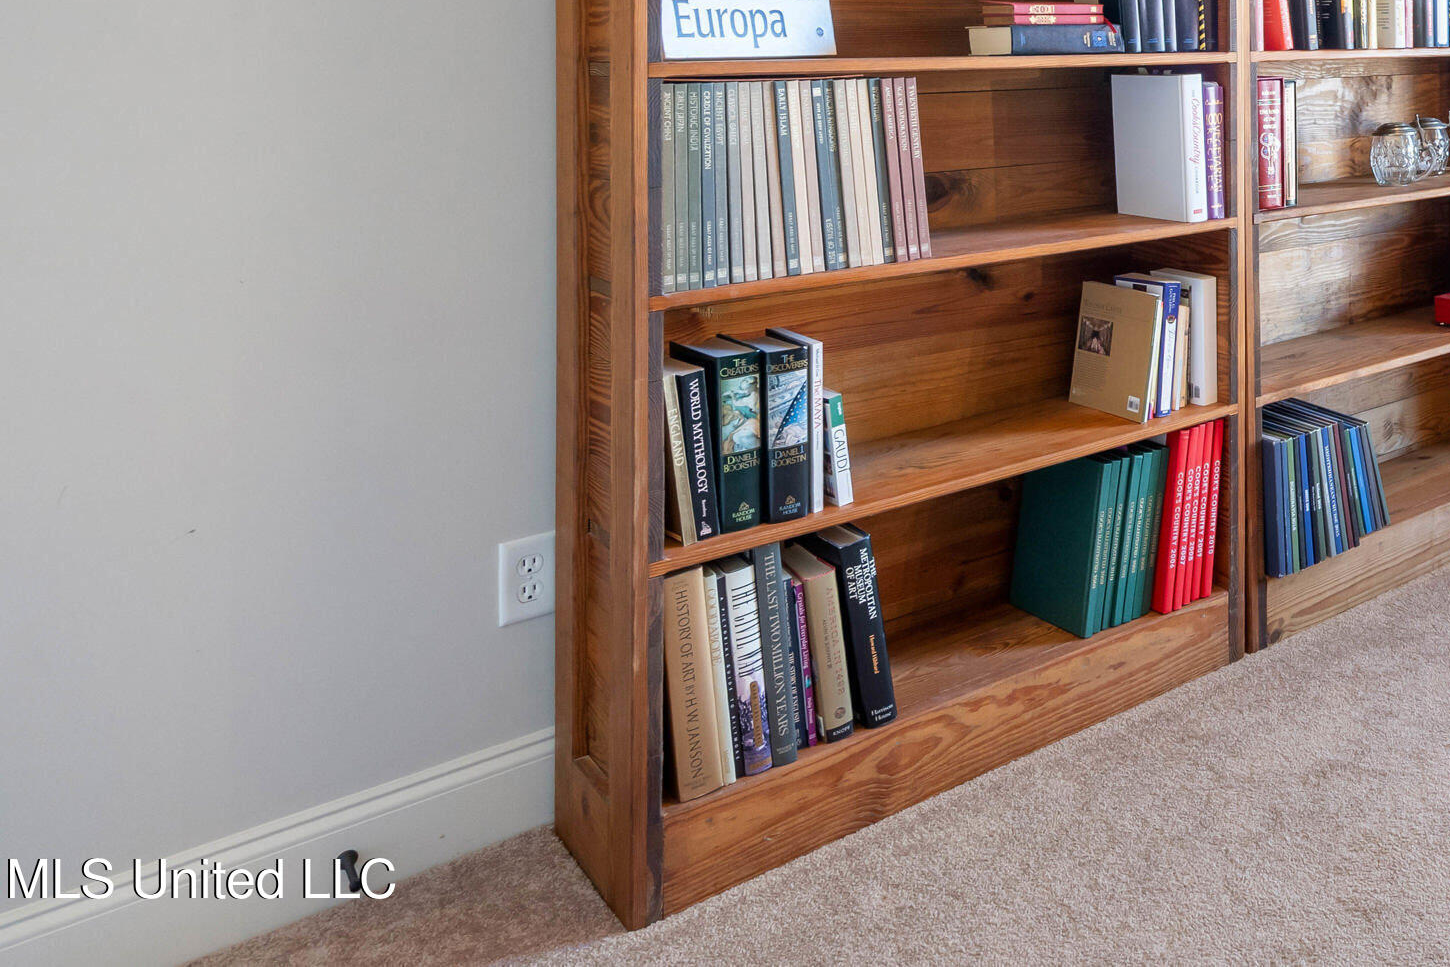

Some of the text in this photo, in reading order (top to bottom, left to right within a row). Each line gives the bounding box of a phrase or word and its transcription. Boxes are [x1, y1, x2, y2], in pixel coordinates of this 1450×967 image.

[672, 0, 788, 48] Europa
[703, 91, 711, 115] CRADLE
[777, 88, 788, 136] EARLY ISLAM
[690, 92, 698, 151] HISTORIC INDIA
[704, 117, 711, 126] OF
[1206, 128, 1214, 192] RECIPES
[1212, 125, 1222, 192] VEGETARIAN
[719, 363, 759, 377] CREATORS
[732, 359, 747, 368] THE
[766, 359, 808, 373] DISCOVERERS
[781, 354, 796, 363] THE
[814, 379, 822, 396] The
[814, 397, 822, 429] MAYA
[668, 408, 685, 467] ENGLAND
[689, 378, 709, 494] WORLD MYTHOLOGY
[723, 458, 760, 473] BOORSTIN
[727, 453, 752, 465] DANIEL
[771, 453, 807, 468] BOORSTIN
[774, 448, 799, 459] DANIEL
[1185, 469, 1194, 501] COOK'S
[1193, 466, 1201, 497] COOK'S
[1202, 462, 1210, 494] COOK'S
[1212, 460, 1220, 491] COOK'S
[1324, 445, 1335, 498] MEDITERRANEAN
[1175, 472, 1184, 504] COOK'S
[732, 508, 756, 518] RANDOM
[735, 514, 752, 523] HOUSE
[1172, 506, 1181, 546] COUNTRY
[1182, 503, 1191, 542] COUNTRY
[1190, 500, 1198, 538] COUNTRY
[1198, 496, 1207, 535] COUNTRY
[1210, 493, 1218, 532] COUNTRY
[764, 552, 775, 579] THE
[868, 557, 877, 578] THE
[731, 581, 757, 610] THE
[765, 582, 779, 609] LAST
[846, 567, 859, 600] OF ART
[853, 565, 867, 604] MUSEUM
[859, 547, 877, 620] METROPOLITAN
[796, 592, 804, 615] Crystals
[721, 607, 729, 657] PICTORIAL
[734, 609, 761, 650] CIVIL
[766, 612, 781, 642] TWO
[799, 625, 808, 649] Everyday
[826, 587, 839, 648] AMERICA
[833, 650, 842, 666] IN
[736, 648, 764, 678] WAR
[770, 644, 786, 693] MILLION
[674, 589, 705, 780] HISTORY OF ART BY H W JANSON
[729, 698, 735, 709] TO
[776, 695, 789, 736] YEARS
[730, 715, 740, 761] BILTMORE
